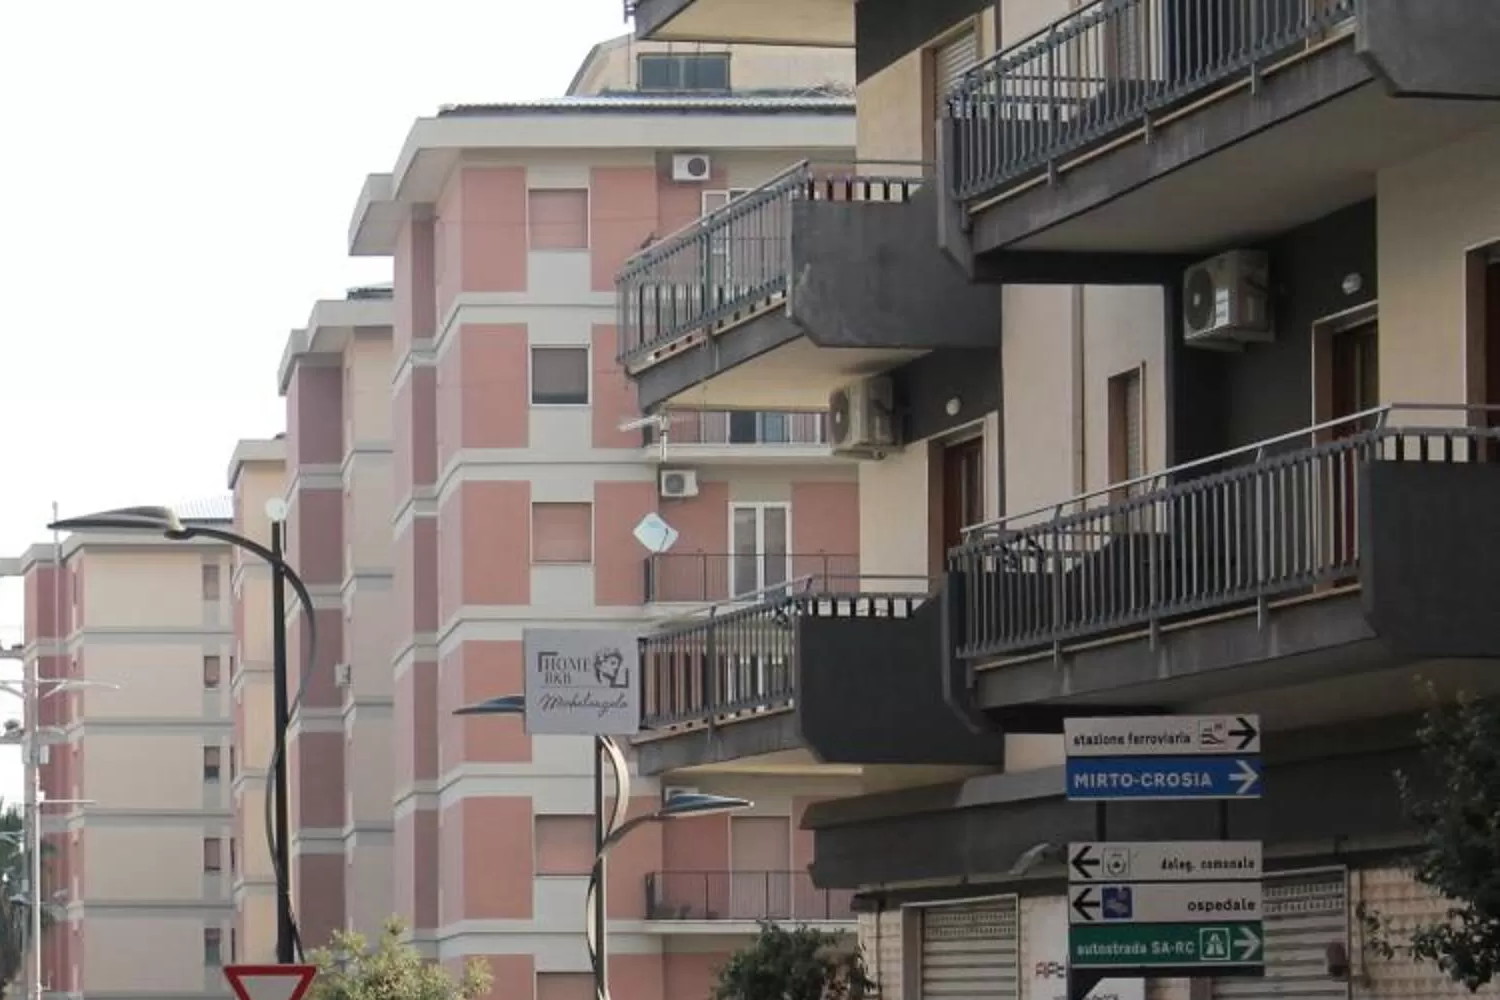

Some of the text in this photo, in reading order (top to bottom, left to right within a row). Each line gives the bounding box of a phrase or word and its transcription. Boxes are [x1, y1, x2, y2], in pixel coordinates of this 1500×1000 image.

[1073, 731, 1192, 746] stazione ferroviaria
[1074, 772, 1214, 789] MIRTO-CROSIA
[1187, 898, 1257, 913] ospedale
[1076, 941, 1148, 957] autostrada
